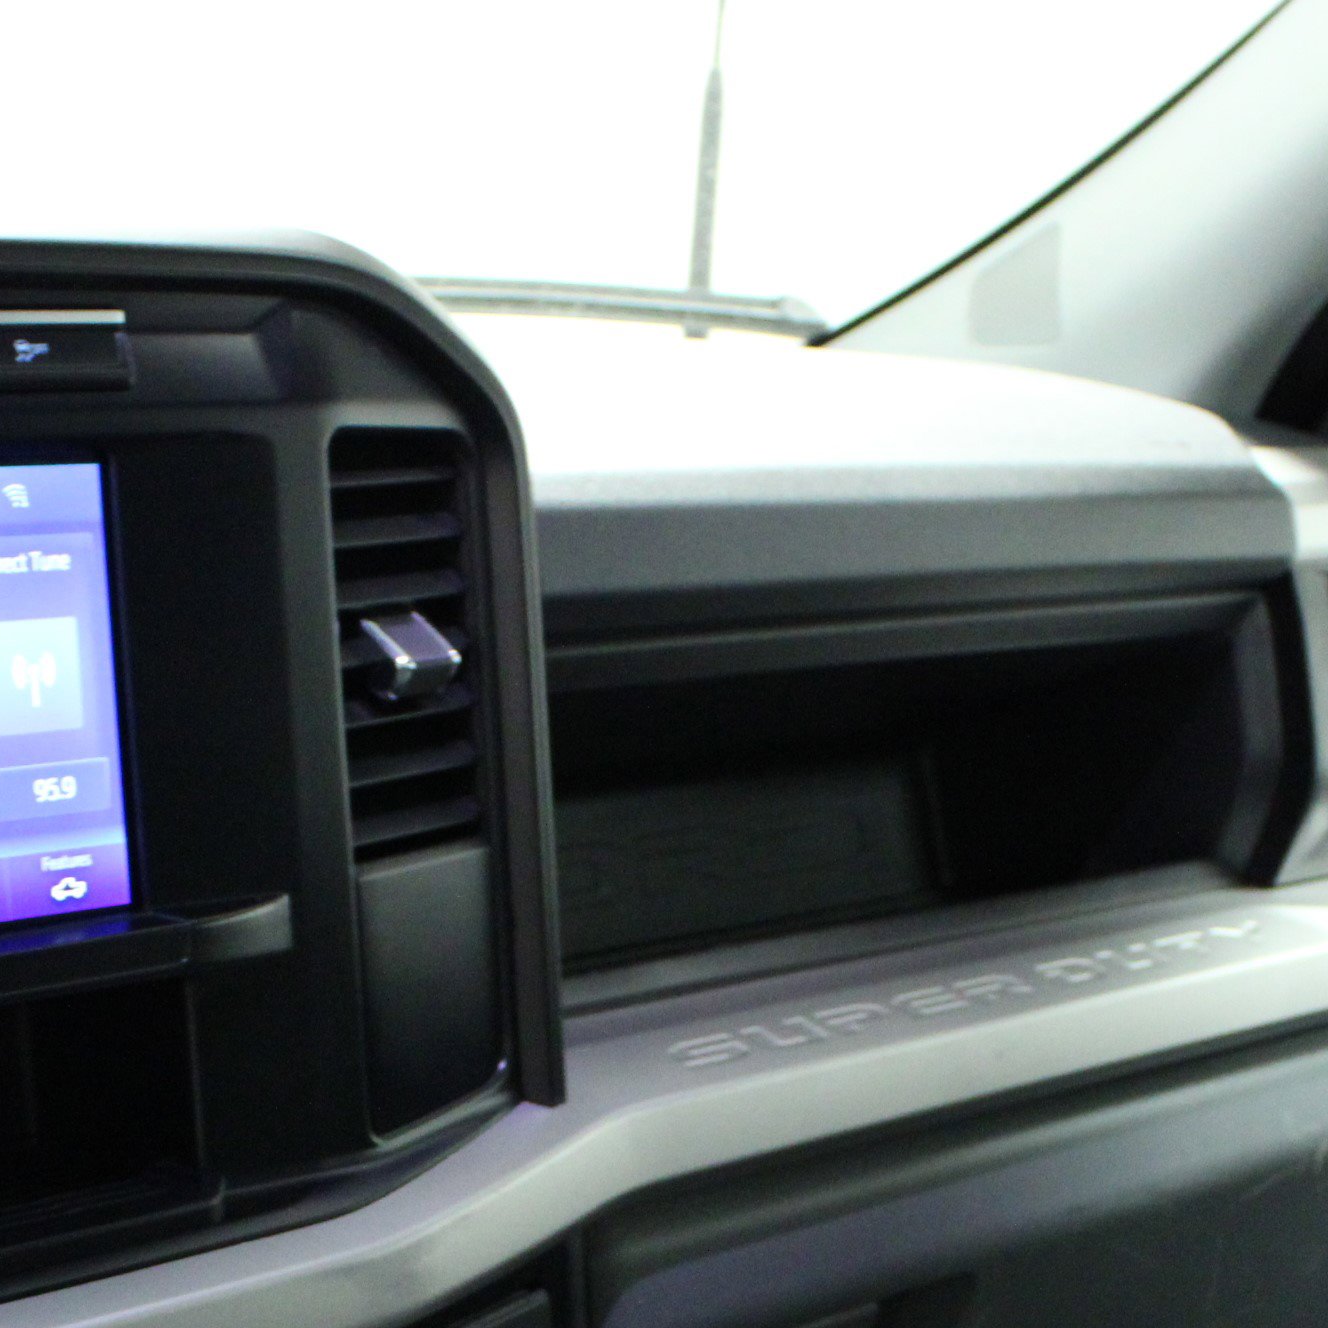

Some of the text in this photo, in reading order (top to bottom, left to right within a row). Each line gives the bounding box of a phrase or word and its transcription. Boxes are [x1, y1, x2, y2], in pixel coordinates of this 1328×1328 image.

[29, 551, 71, 572] Tune
[33, 776, 76, 801] 95.9
[670, 919, 1260, 1067] SUPER DUTY
